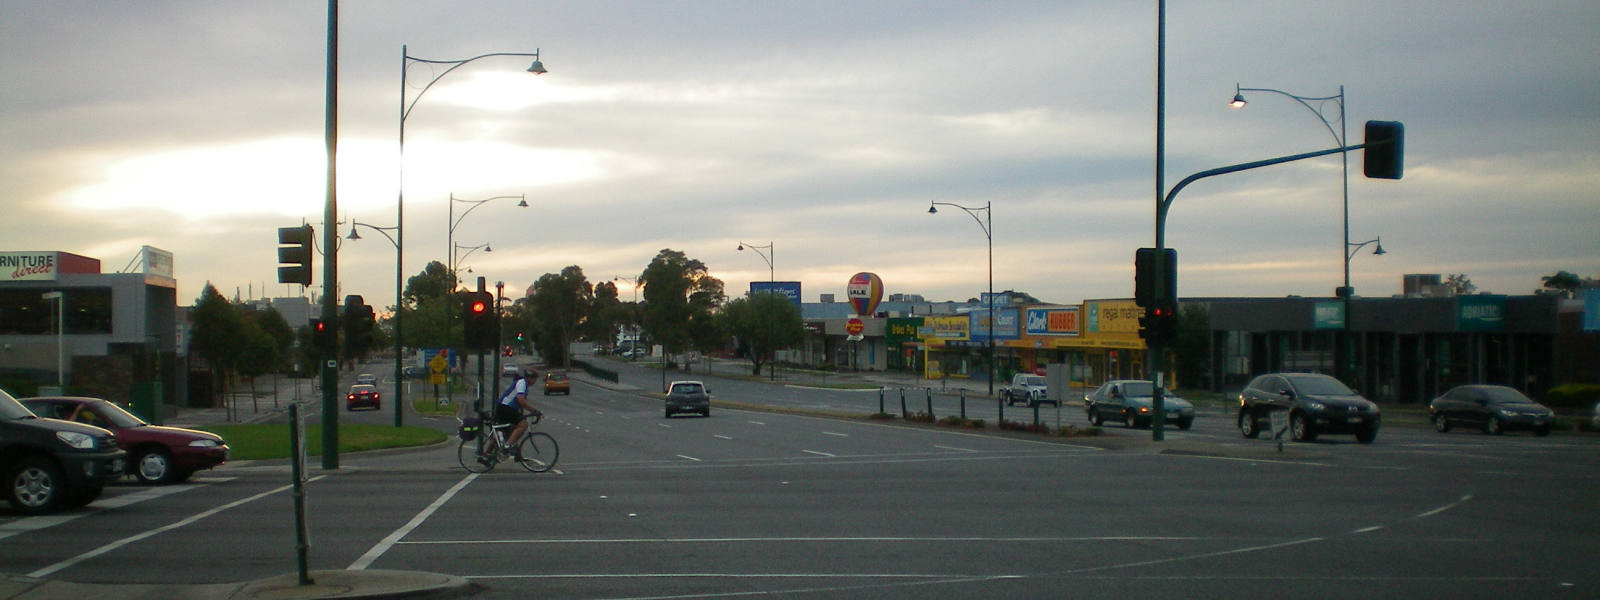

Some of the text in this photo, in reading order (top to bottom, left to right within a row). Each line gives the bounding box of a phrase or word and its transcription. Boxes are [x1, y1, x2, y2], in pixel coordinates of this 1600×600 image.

[12, 263, 53, 280] direct
[1028, 311, 1076, 331] Clark RUBBER
